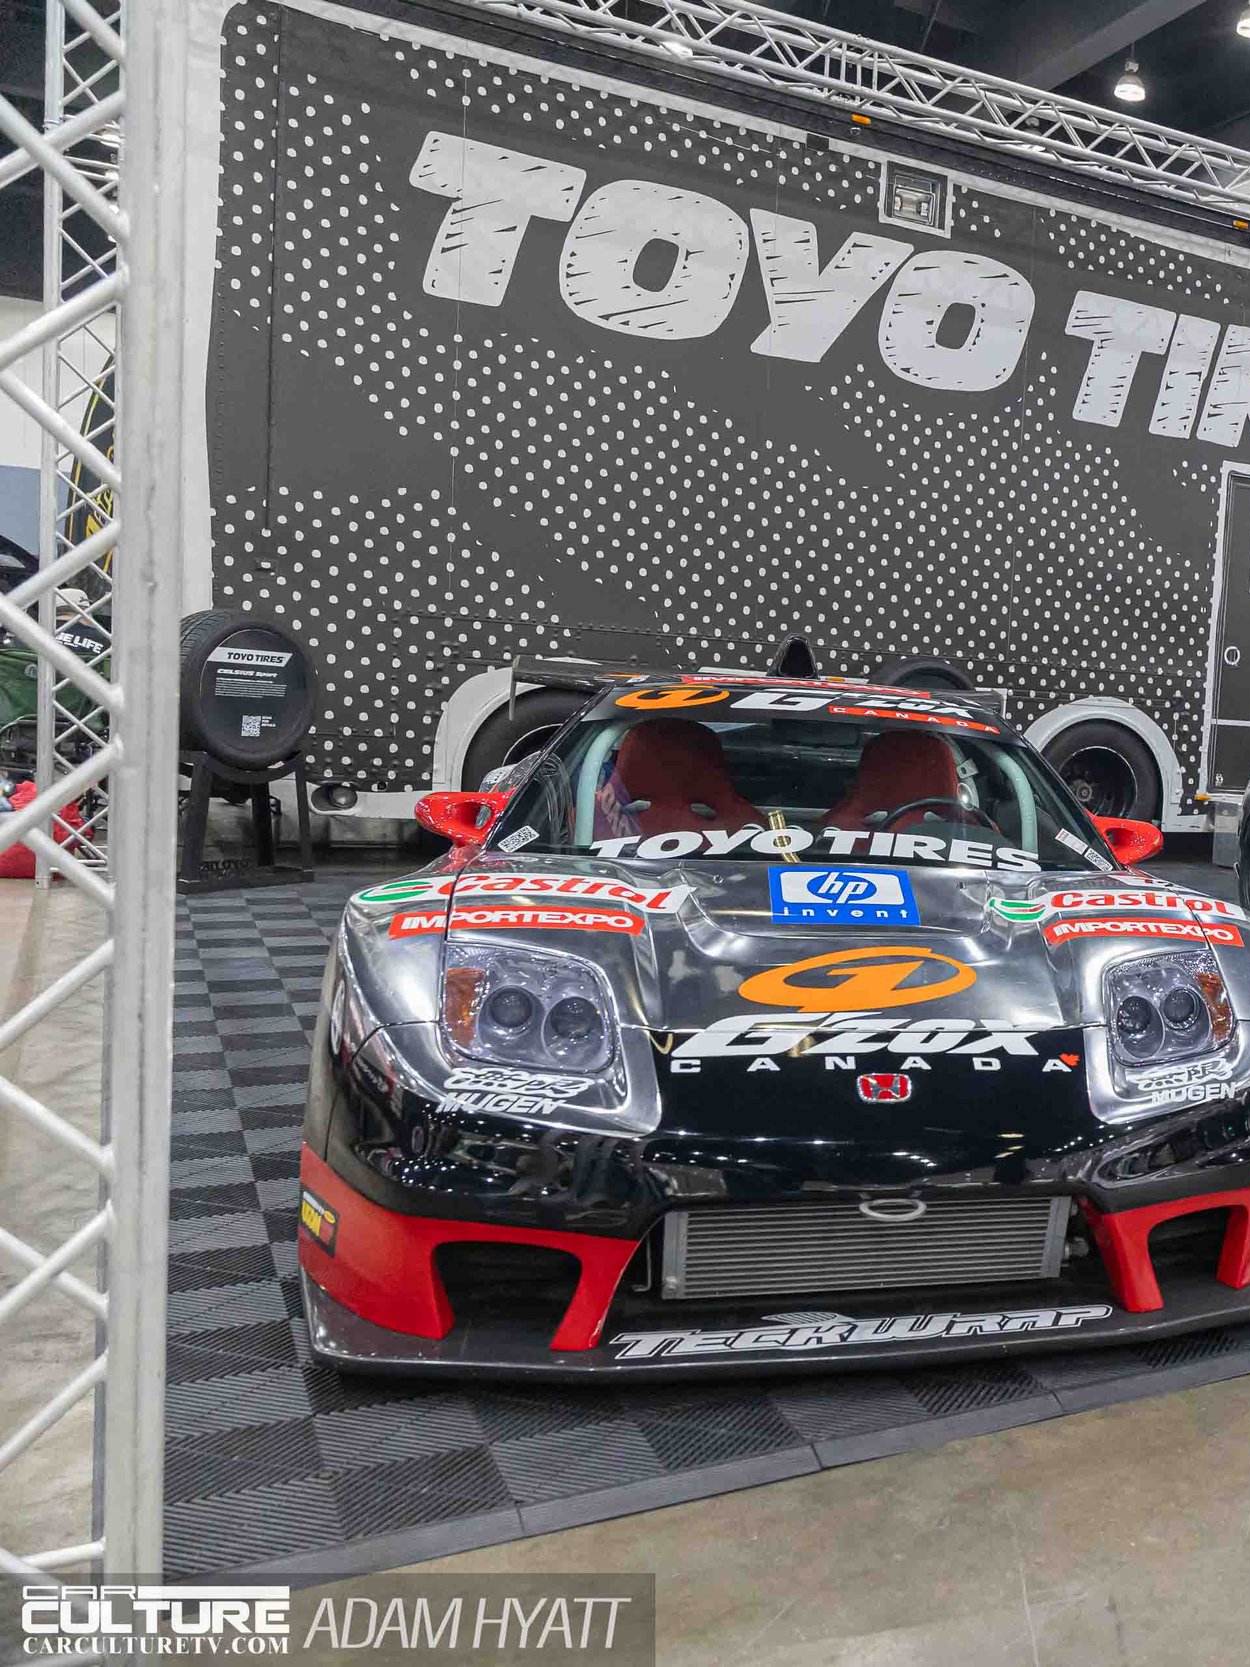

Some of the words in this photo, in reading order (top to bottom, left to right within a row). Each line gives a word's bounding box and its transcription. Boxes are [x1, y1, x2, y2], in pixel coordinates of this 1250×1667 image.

[409, 131, 1036, 392] TOYO
[73, 635, 104, 654] LIFE
[227, 652, 254, 661] TOYO
[255, 654, 285, 664] TIRES
[832, 706, 997, 733] CANADA
[586, 828, 814, 860] TOYO
[822, 830, 1043, 872] TIRES
[437, 874, 673, 910] Castrol
[818, 872, 872, 904] hp
[783, 907, 908, 919] invent
[1051, 891, 1237, 916] Castrol
[401, 910, 634, 930] IMPORTEXPO
[1053, 921, 1234, 941] IMPORTEXPO
[669, 1055, 1072, 1073] CANADA
[435, 1092, 567, 1115] MUGEN
[1151, 1082, 1237, 1105] MUGEN
[609, 1305, 1114, 1360] TECKWRAP
